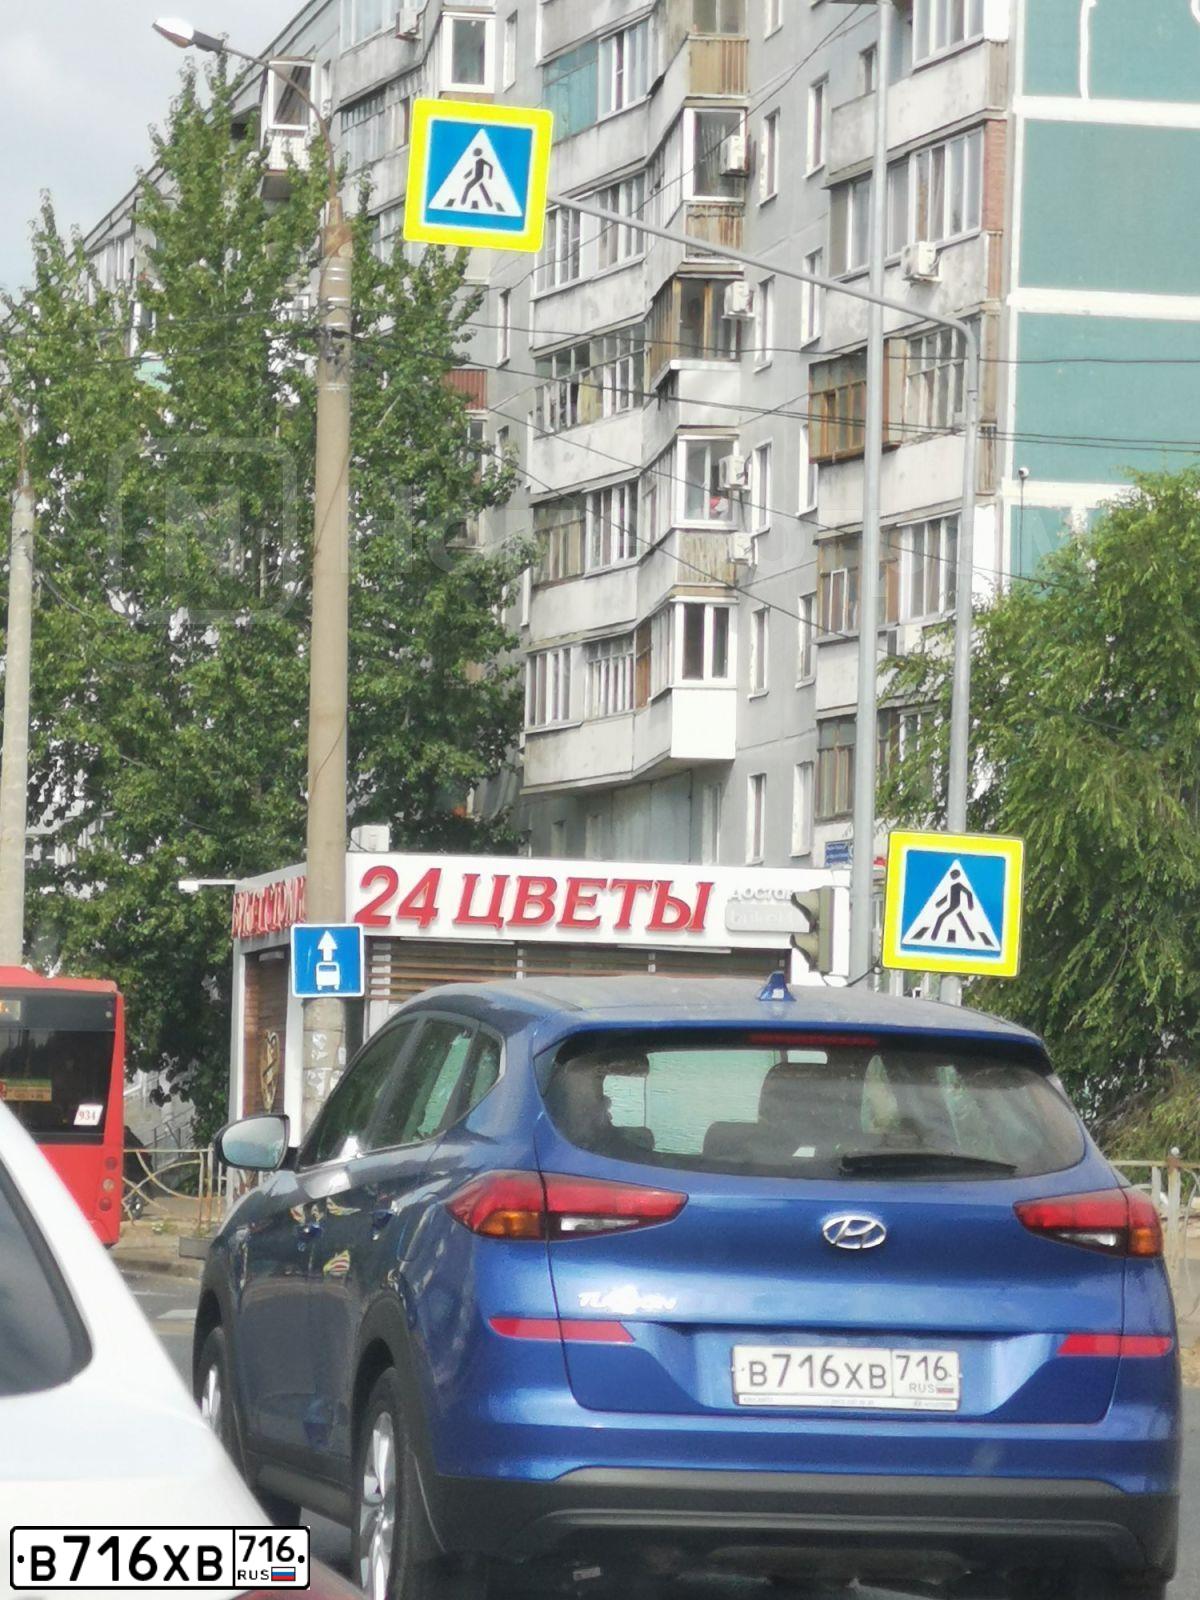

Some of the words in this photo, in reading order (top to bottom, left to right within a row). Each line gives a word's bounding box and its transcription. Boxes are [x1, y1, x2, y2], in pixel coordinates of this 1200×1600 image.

[353, 866, 441, 928] 24
[453, 873, 713, 932] ЦВЕТЫ
[749, 1353, 887, 1390] В716ХВ
[896, 1354, 948, 1381] 716
[909, 1383, 935, 1393] RUS
